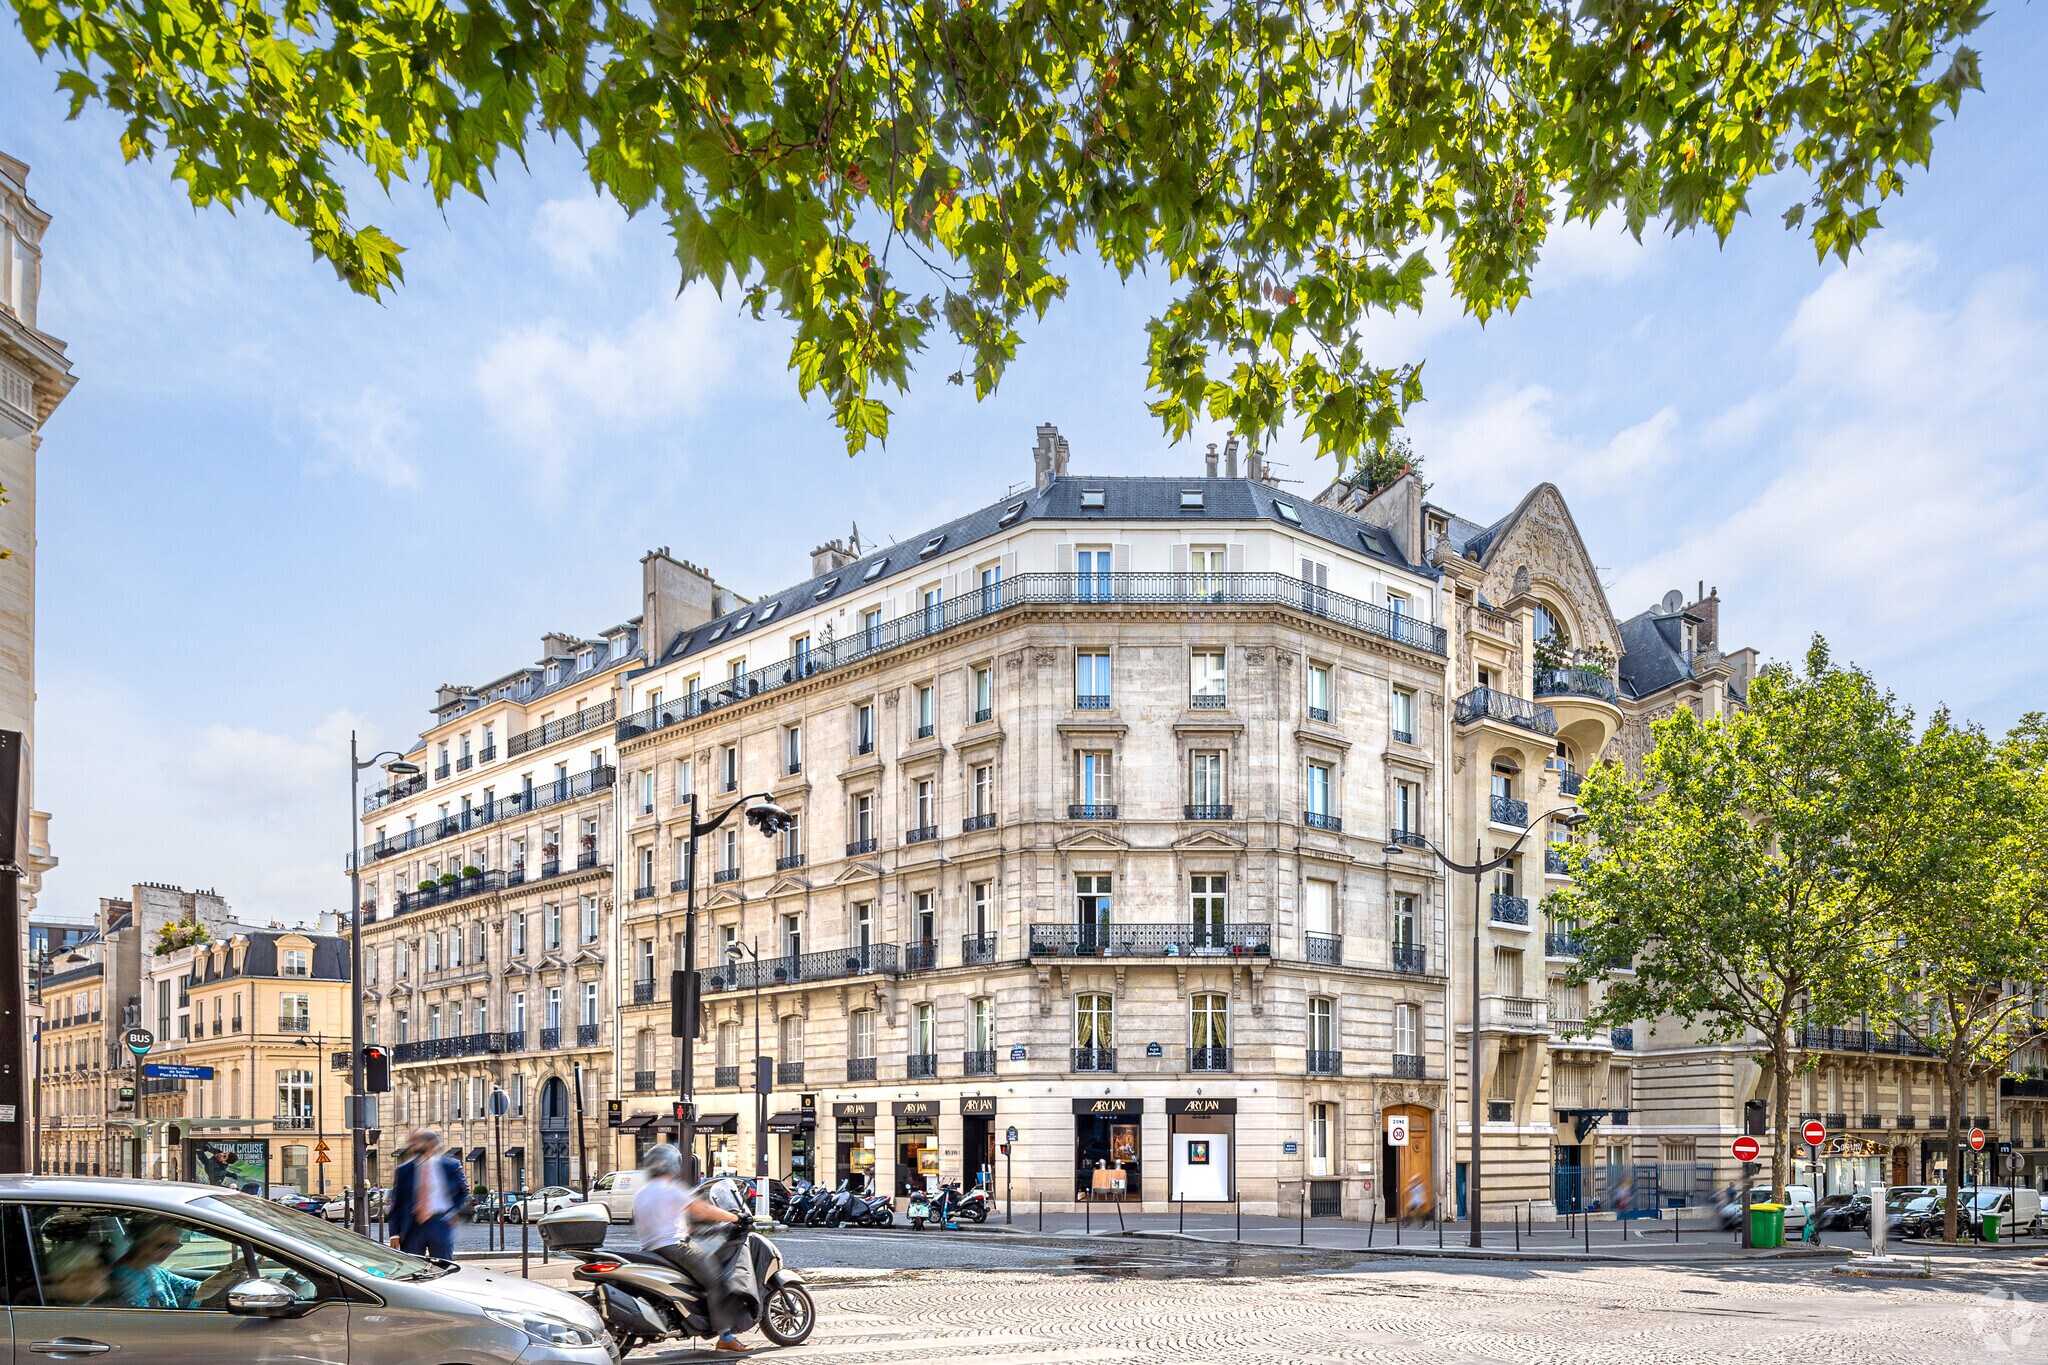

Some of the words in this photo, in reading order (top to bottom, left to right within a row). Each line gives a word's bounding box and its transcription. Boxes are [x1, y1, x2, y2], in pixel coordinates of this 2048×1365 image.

[130, 1034, 150, 1043] BUS
[856, 1105, 865, 1113] JAN
[904, 1103, 916, 1113] ARY
[917, 1103, 927, 1113] JAN
[964, 1100, 979, 1111] ARY
[980, 1100, 993, 1111] JAN
[1091, 1101, 1110, 1111] ARY
[1111, 1101, 1126, 1111] JAN
[1184, 1101, 1203, 1111] ARY
[1204, 1101, 1219, 1111] JAN
[236, 1143, 263, 1153] CRUISE
